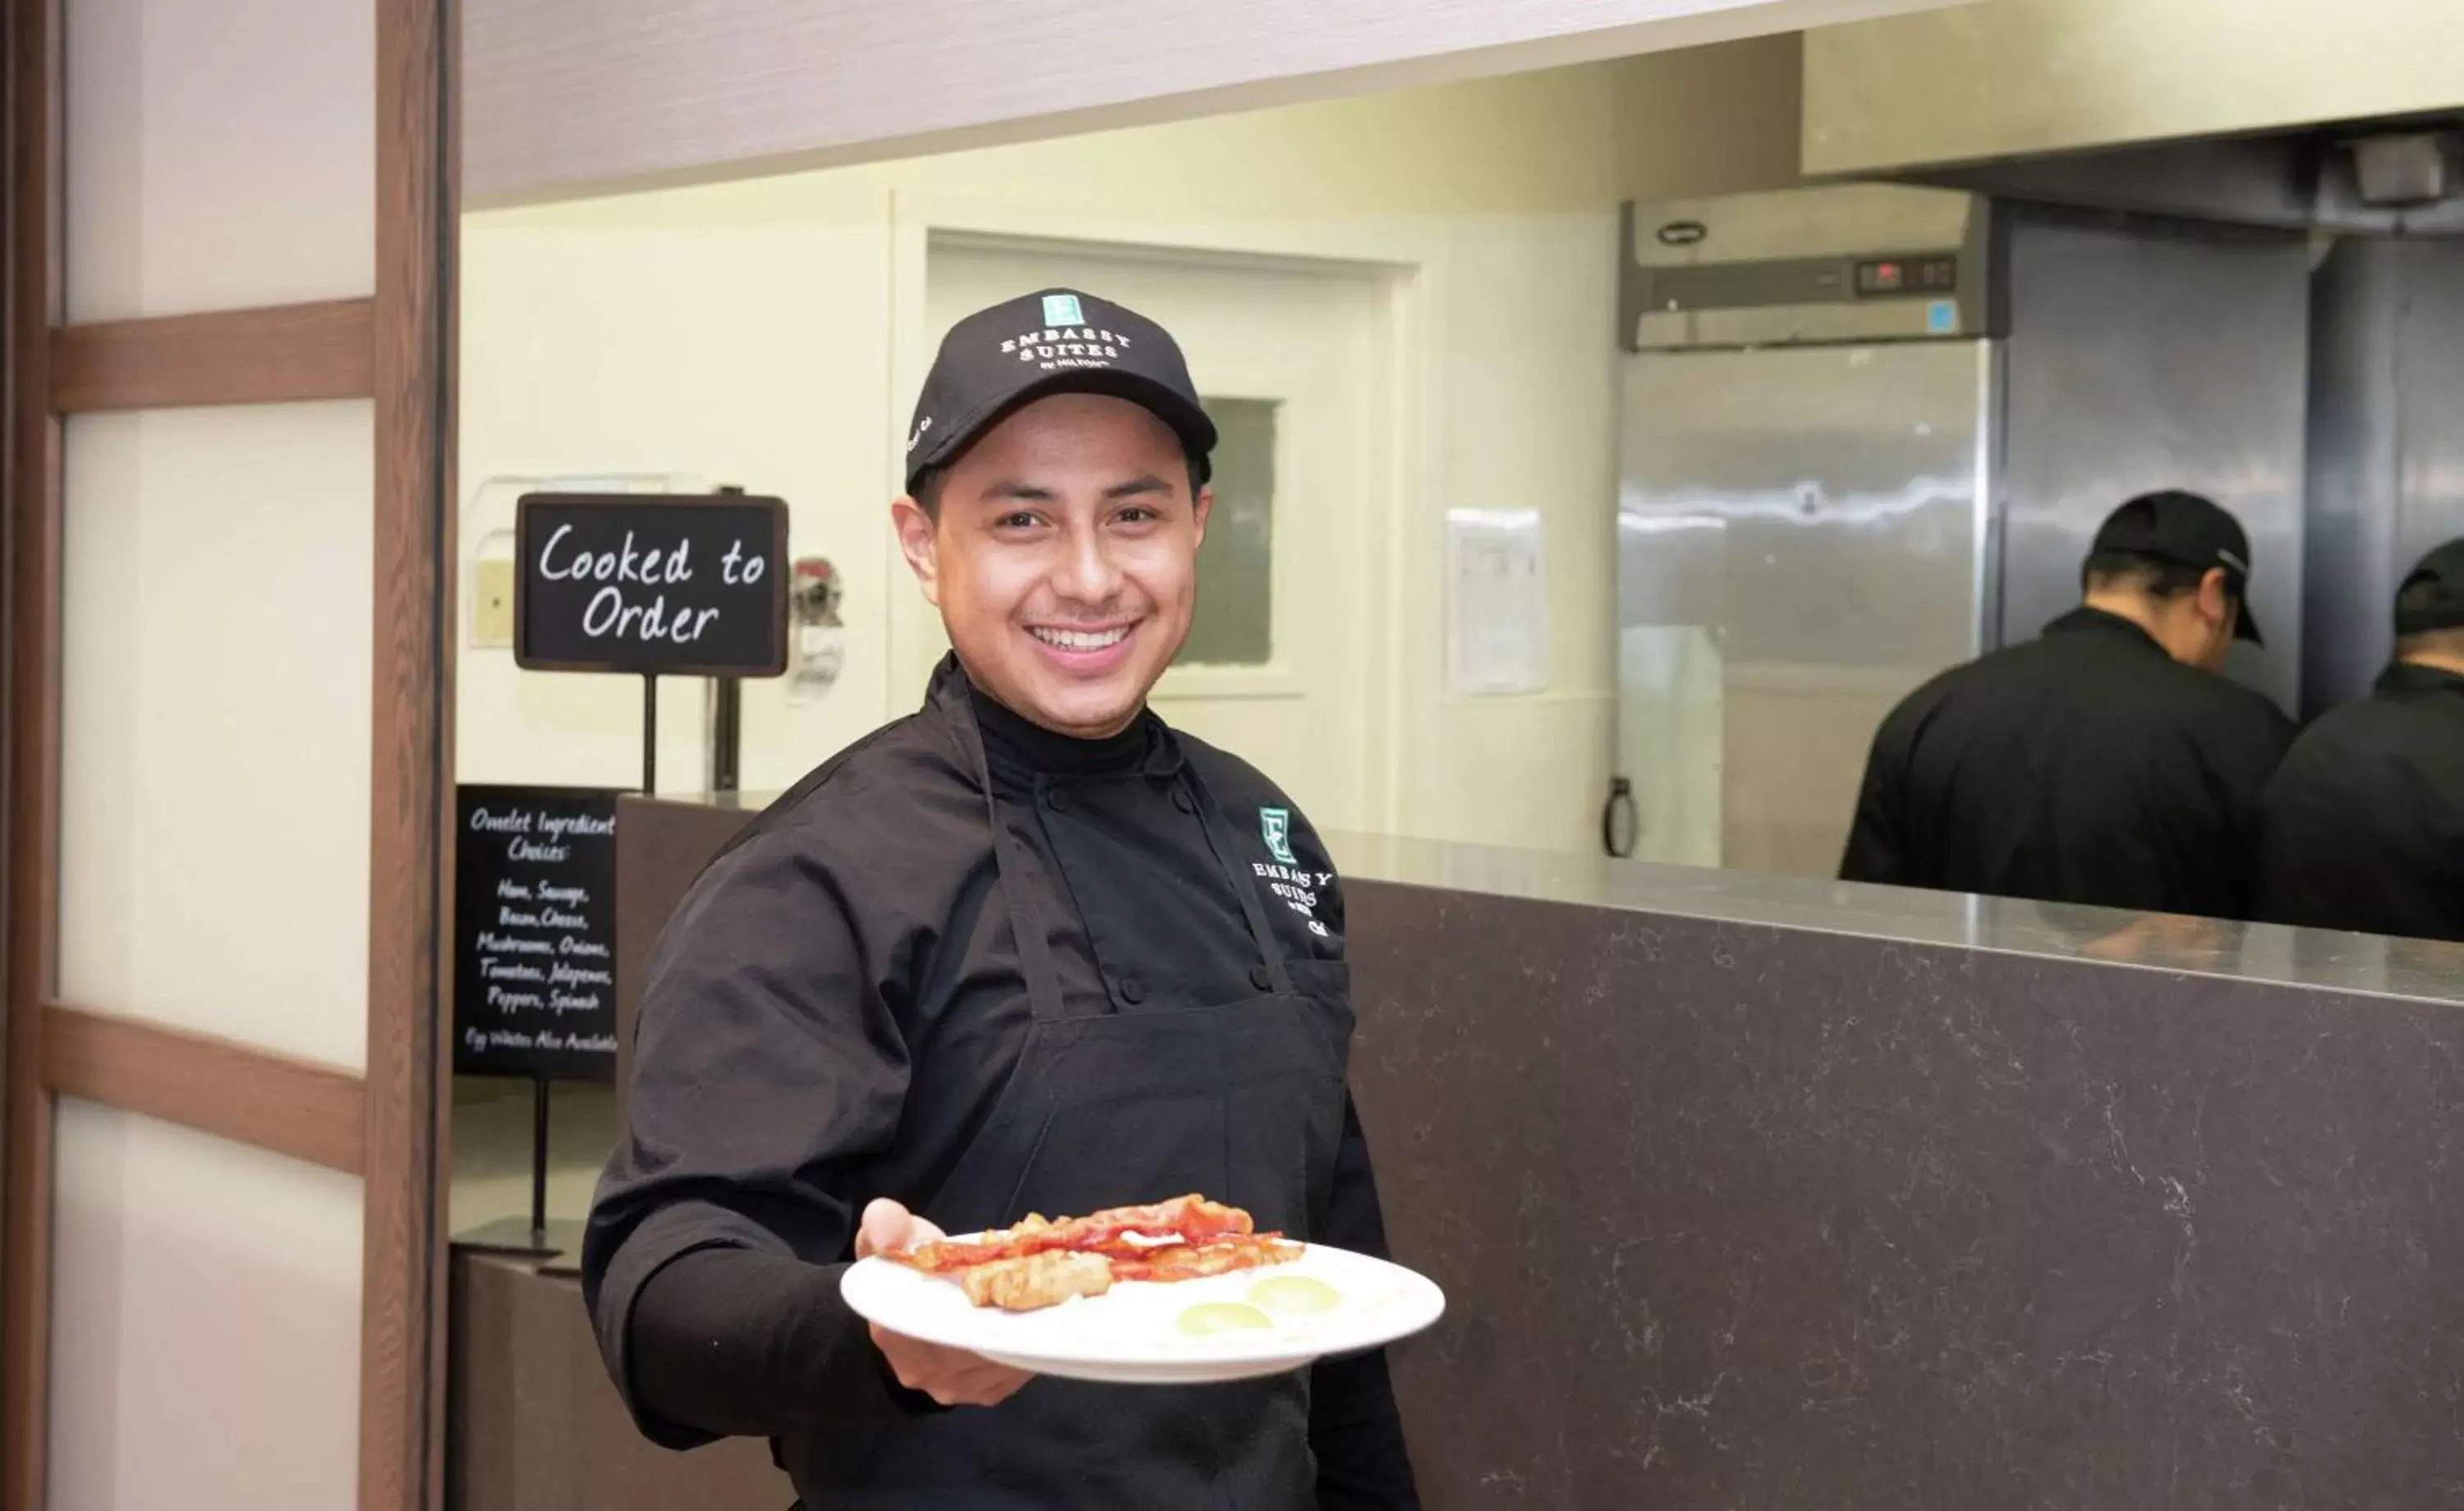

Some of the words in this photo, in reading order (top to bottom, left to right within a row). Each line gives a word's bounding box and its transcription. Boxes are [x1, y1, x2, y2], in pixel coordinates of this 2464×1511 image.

[1000, 328, 1130, 353] EMBASSY
[1019, 344, 1118, 361] SUITES
[539, 524, 692, 585] Cooked
[721, 539, 765, 585] to
[582, 586, 720, 643] Order
[470, 806, 532, 833] Omelet
[559, 935, 610, 958] Onions,
[548, 988, 600, 1017] Spinach
